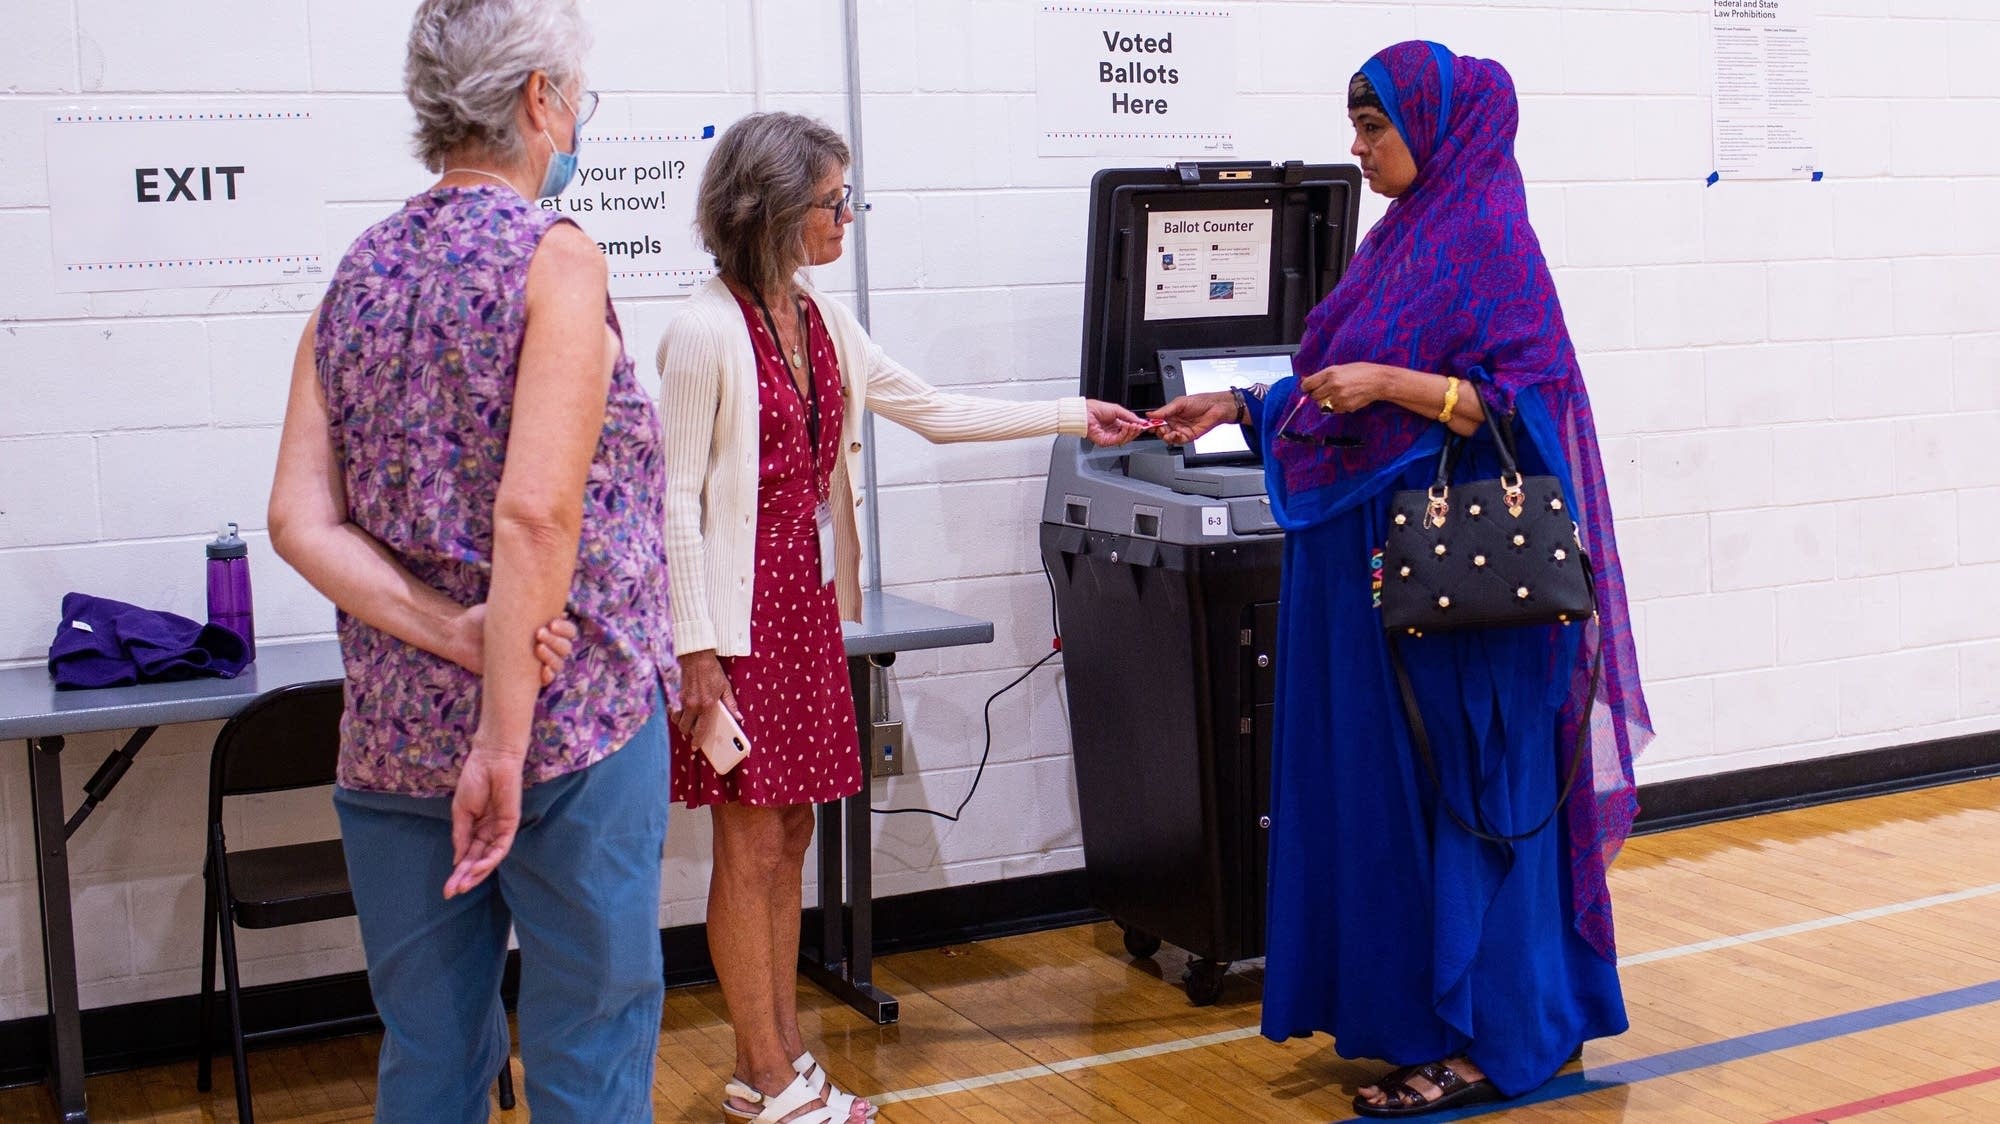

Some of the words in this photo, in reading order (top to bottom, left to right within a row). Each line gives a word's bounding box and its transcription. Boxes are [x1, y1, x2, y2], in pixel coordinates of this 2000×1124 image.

[1714, 0, 1742, 8] Federal
[1743, 0, 1757, 8] and
[1758, 0, 1779, 9] State
[1714, 9, 1730, 18] Law
[1731, 9, 1776, 19] Prohibitions
[1102, 30, 1173, 54] Voted
[1099, 61, 1179, 85] Ballots
[1112, 92, 1168, 115] Here
[135, 165, 245, 203] EXIT
[577, 167, 627, 187] your
[634, 160, 686, 185] poll?
[540, 196, 562, 212] et
[569, 198, 594, 212] us
[600, 190, 666, 212] know!
[1164, 220, 1200, 234] Ballot
[1203, 220, 1254, 233] Counter
[596, 235, 662, 259] empls
[1208, 516, 1222, 526] 6-3
